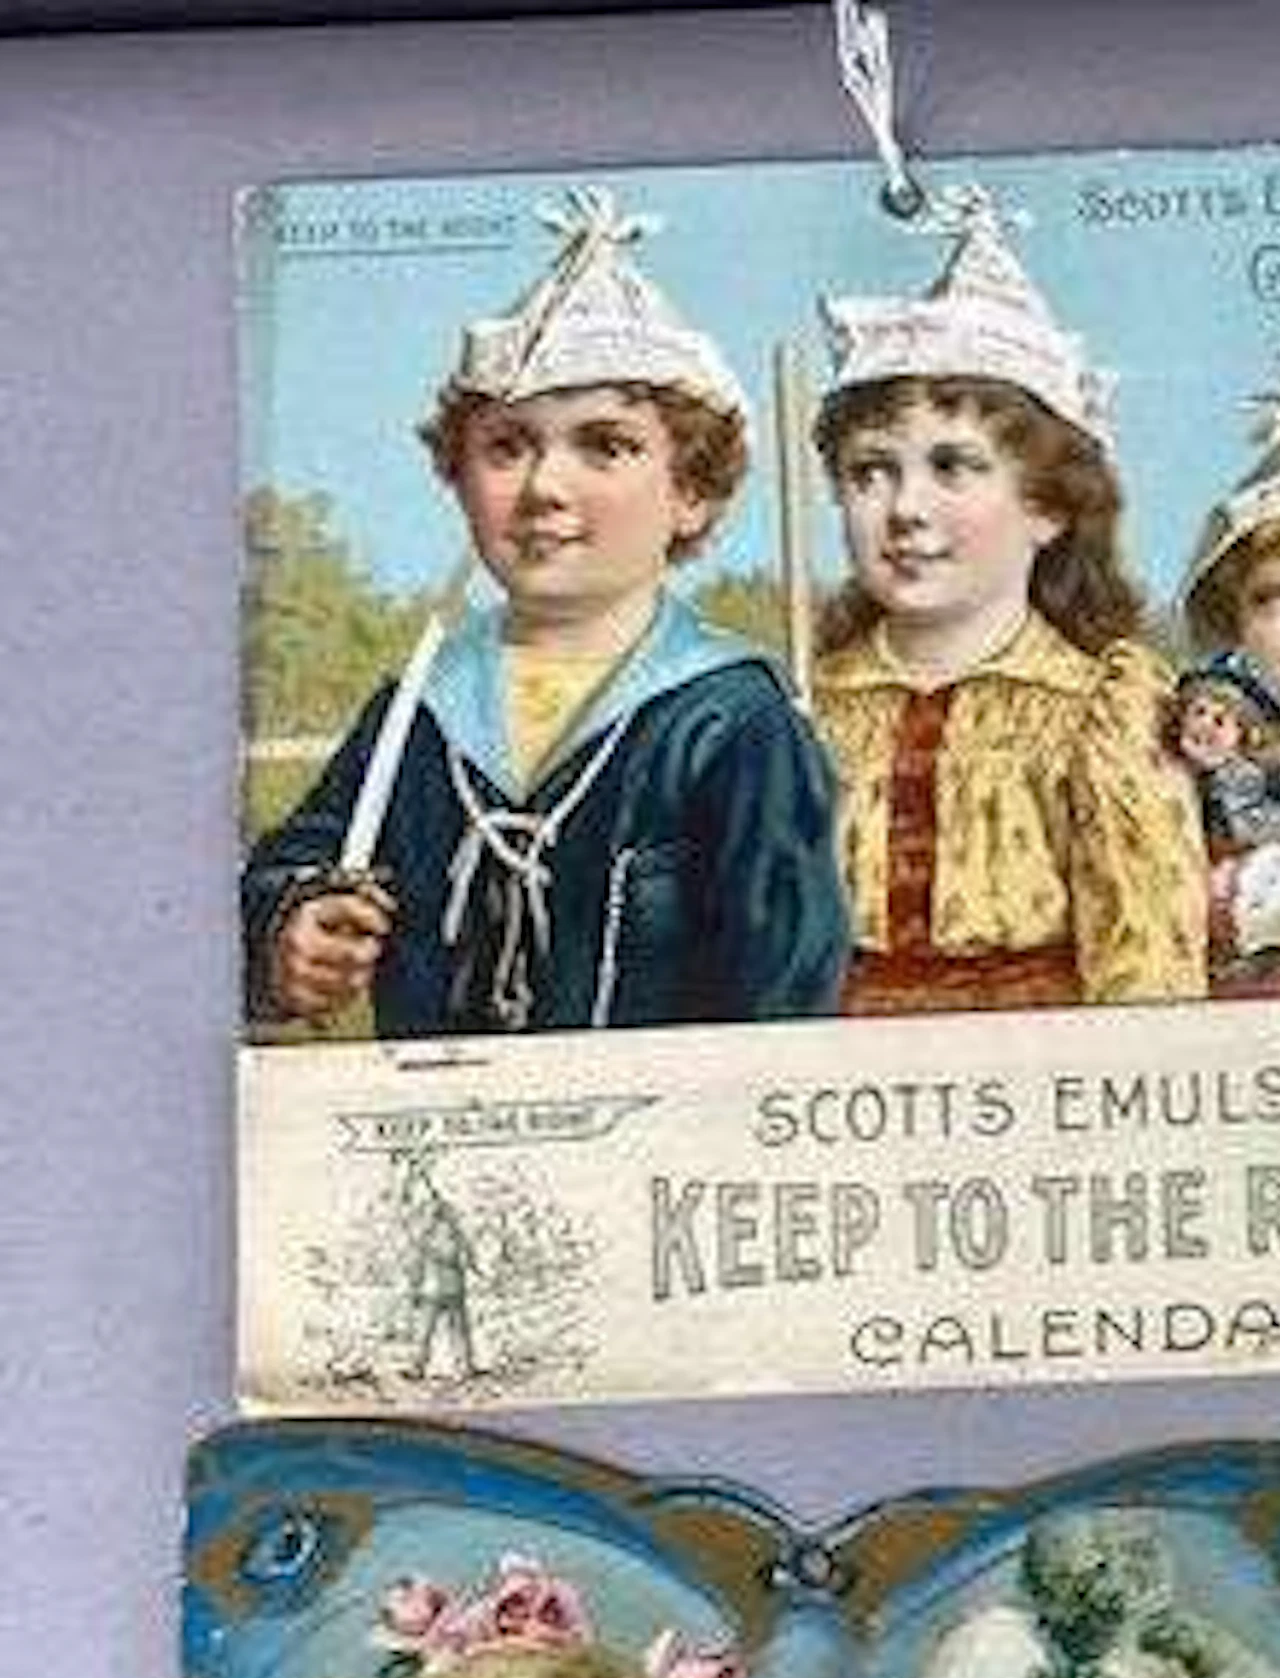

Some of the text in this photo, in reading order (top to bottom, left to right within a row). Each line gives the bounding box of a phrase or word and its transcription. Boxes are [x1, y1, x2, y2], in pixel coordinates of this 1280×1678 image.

[649, 1172, 880, 1302] KEEP
[901, 1178, 1009, 1272] TO
[1032, 1167, 1206, 1265] THE
